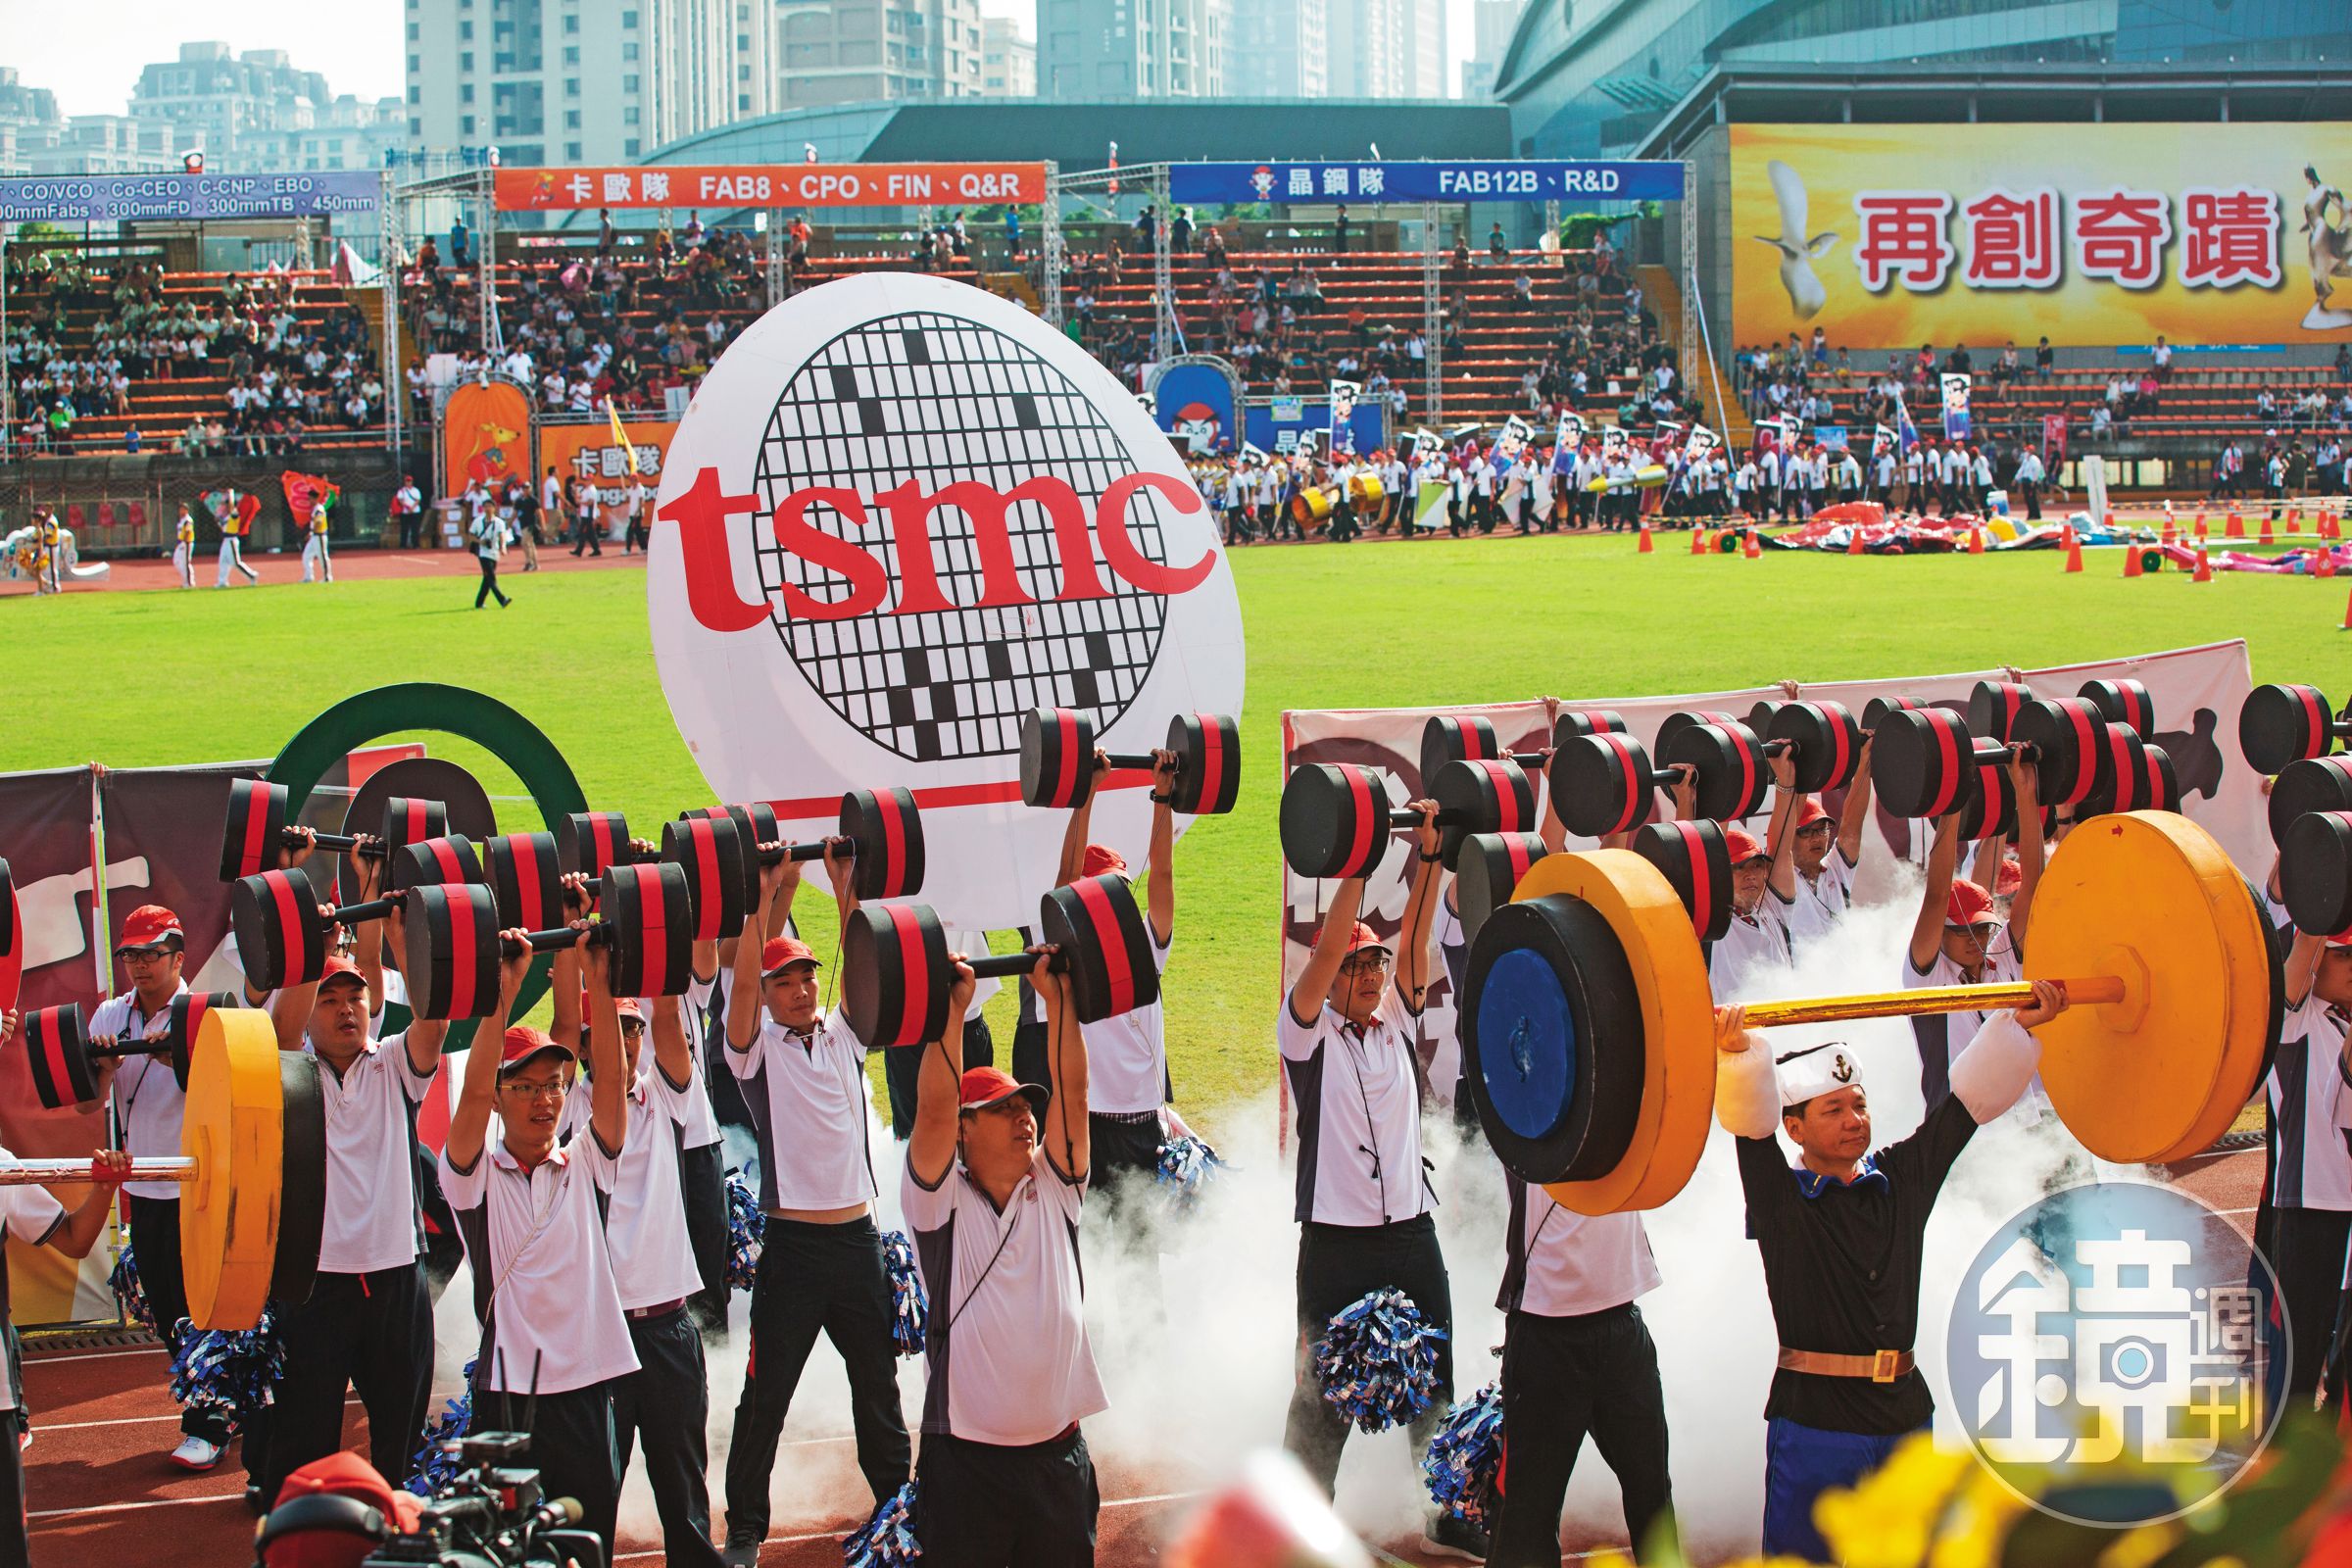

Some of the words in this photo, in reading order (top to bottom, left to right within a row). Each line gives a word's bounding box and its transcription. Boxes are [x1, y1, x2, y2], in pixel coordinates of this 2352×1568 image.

[565, 172, 670, 203] 卡歐隊
[1288, 168, 1385, 196] 晶鋼隊
[312, 195, 374, 211] 450mm
[1856, 188, 2279, 288] 再創奇蹟
[658, 466, 1217, 632] tsmc
